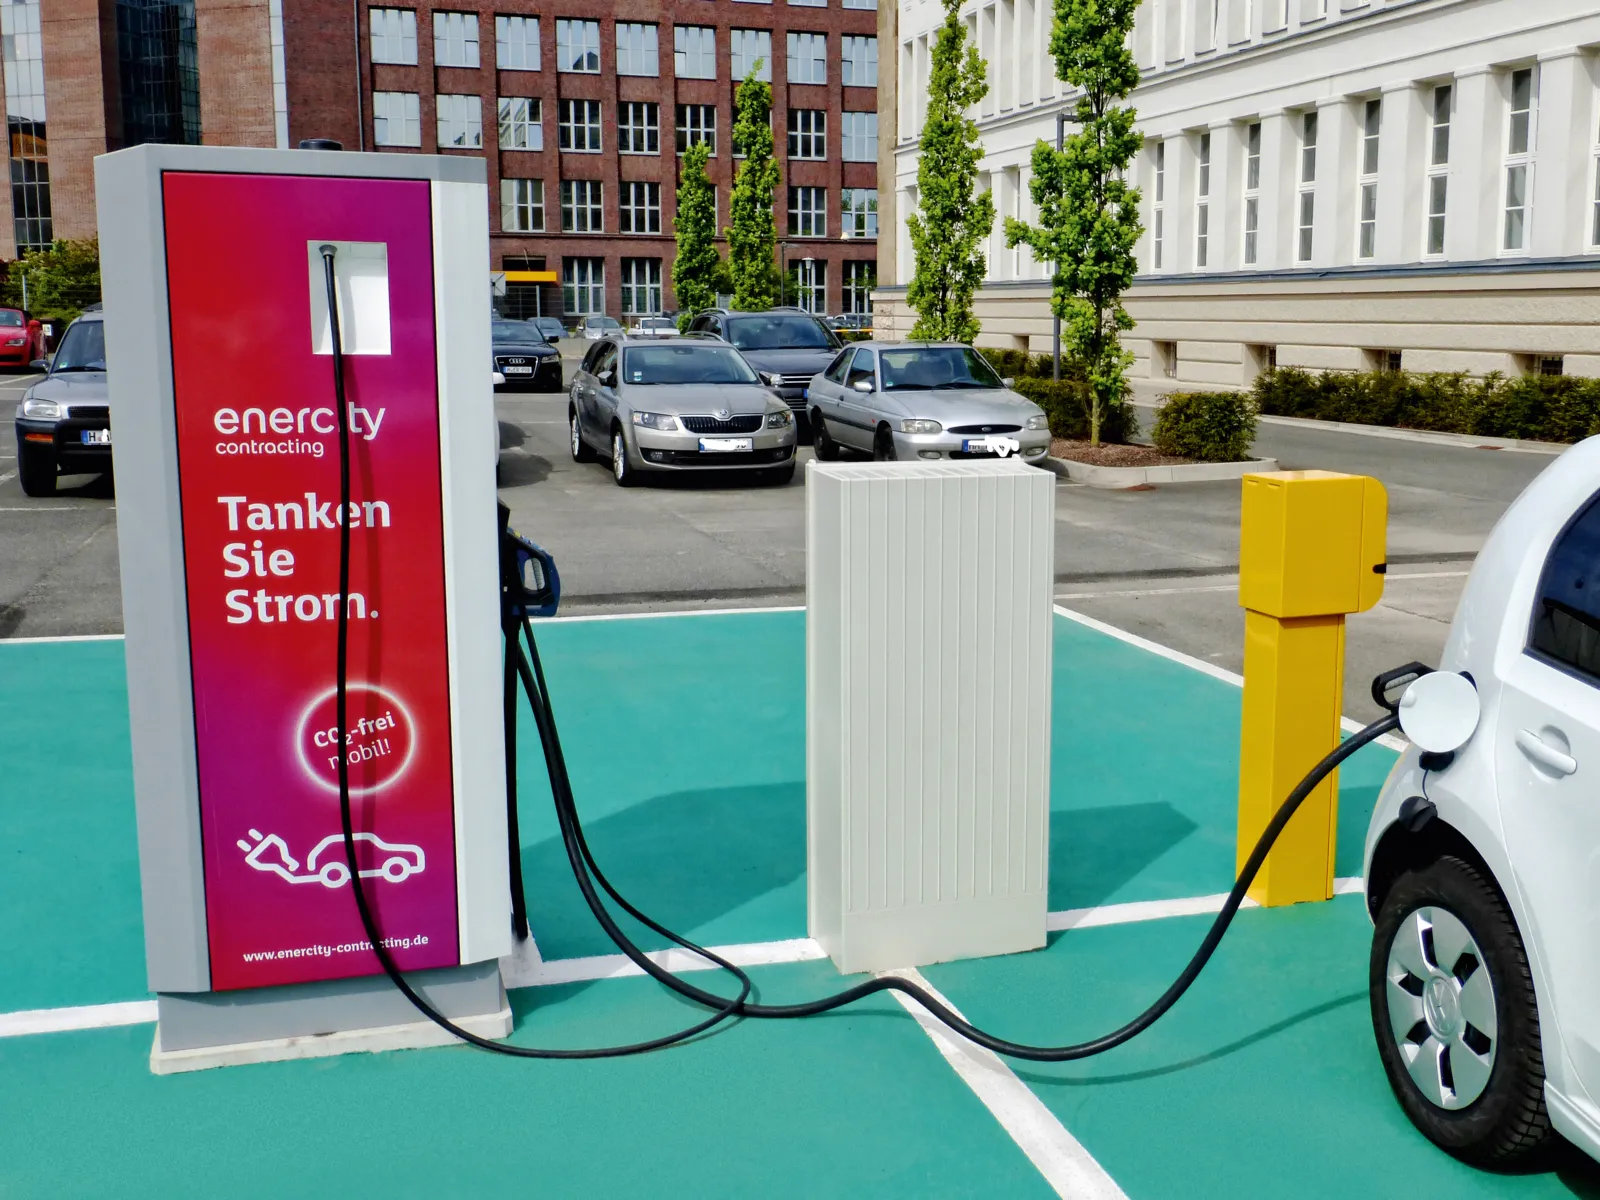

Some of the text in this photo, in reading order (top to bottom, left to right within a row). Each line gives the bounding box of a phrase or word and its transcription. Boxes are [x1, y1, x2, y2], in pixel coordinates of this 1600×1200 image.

[213, 401, 386, 440] enercty
[215, 438, 325, 457] contracting
[217, 492, 391, 531] Tanken
[222, 539, 295, 578] Sie
[225, 588, 379, 624] Strom.
[328, 738, 391, 770] mobil!
